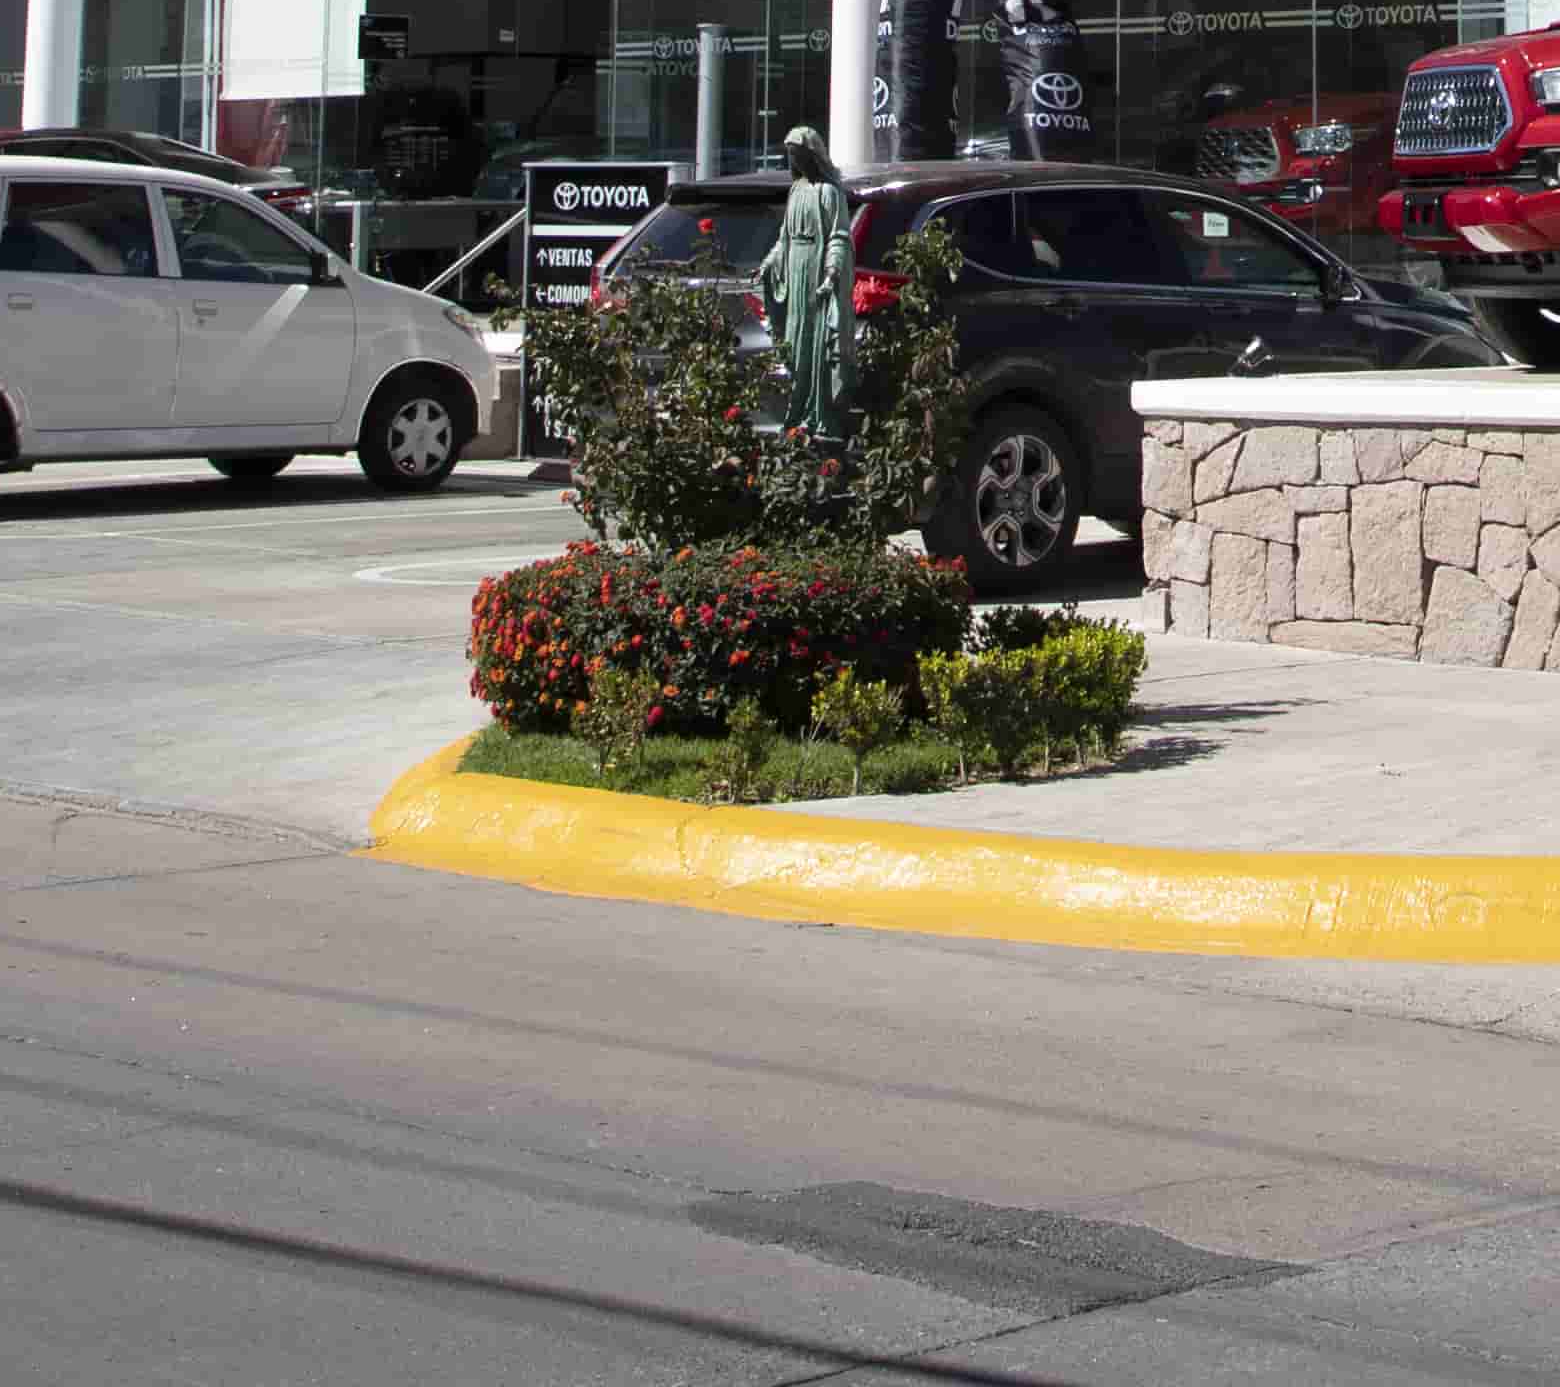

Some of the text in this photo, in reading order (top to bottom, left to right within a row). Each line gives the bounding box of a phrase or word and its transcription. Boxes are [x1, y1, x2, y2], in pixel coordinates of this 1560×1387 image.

[1195, 12, 1263, 33] TOYOTA
[1364, 4, 1438, 26] TOYOTA
[1024, 112, 1091, 132] TOYOTA
[580, 185, 651, 209] TOYOTA
[548, 248, 593, 268] VENTAS
